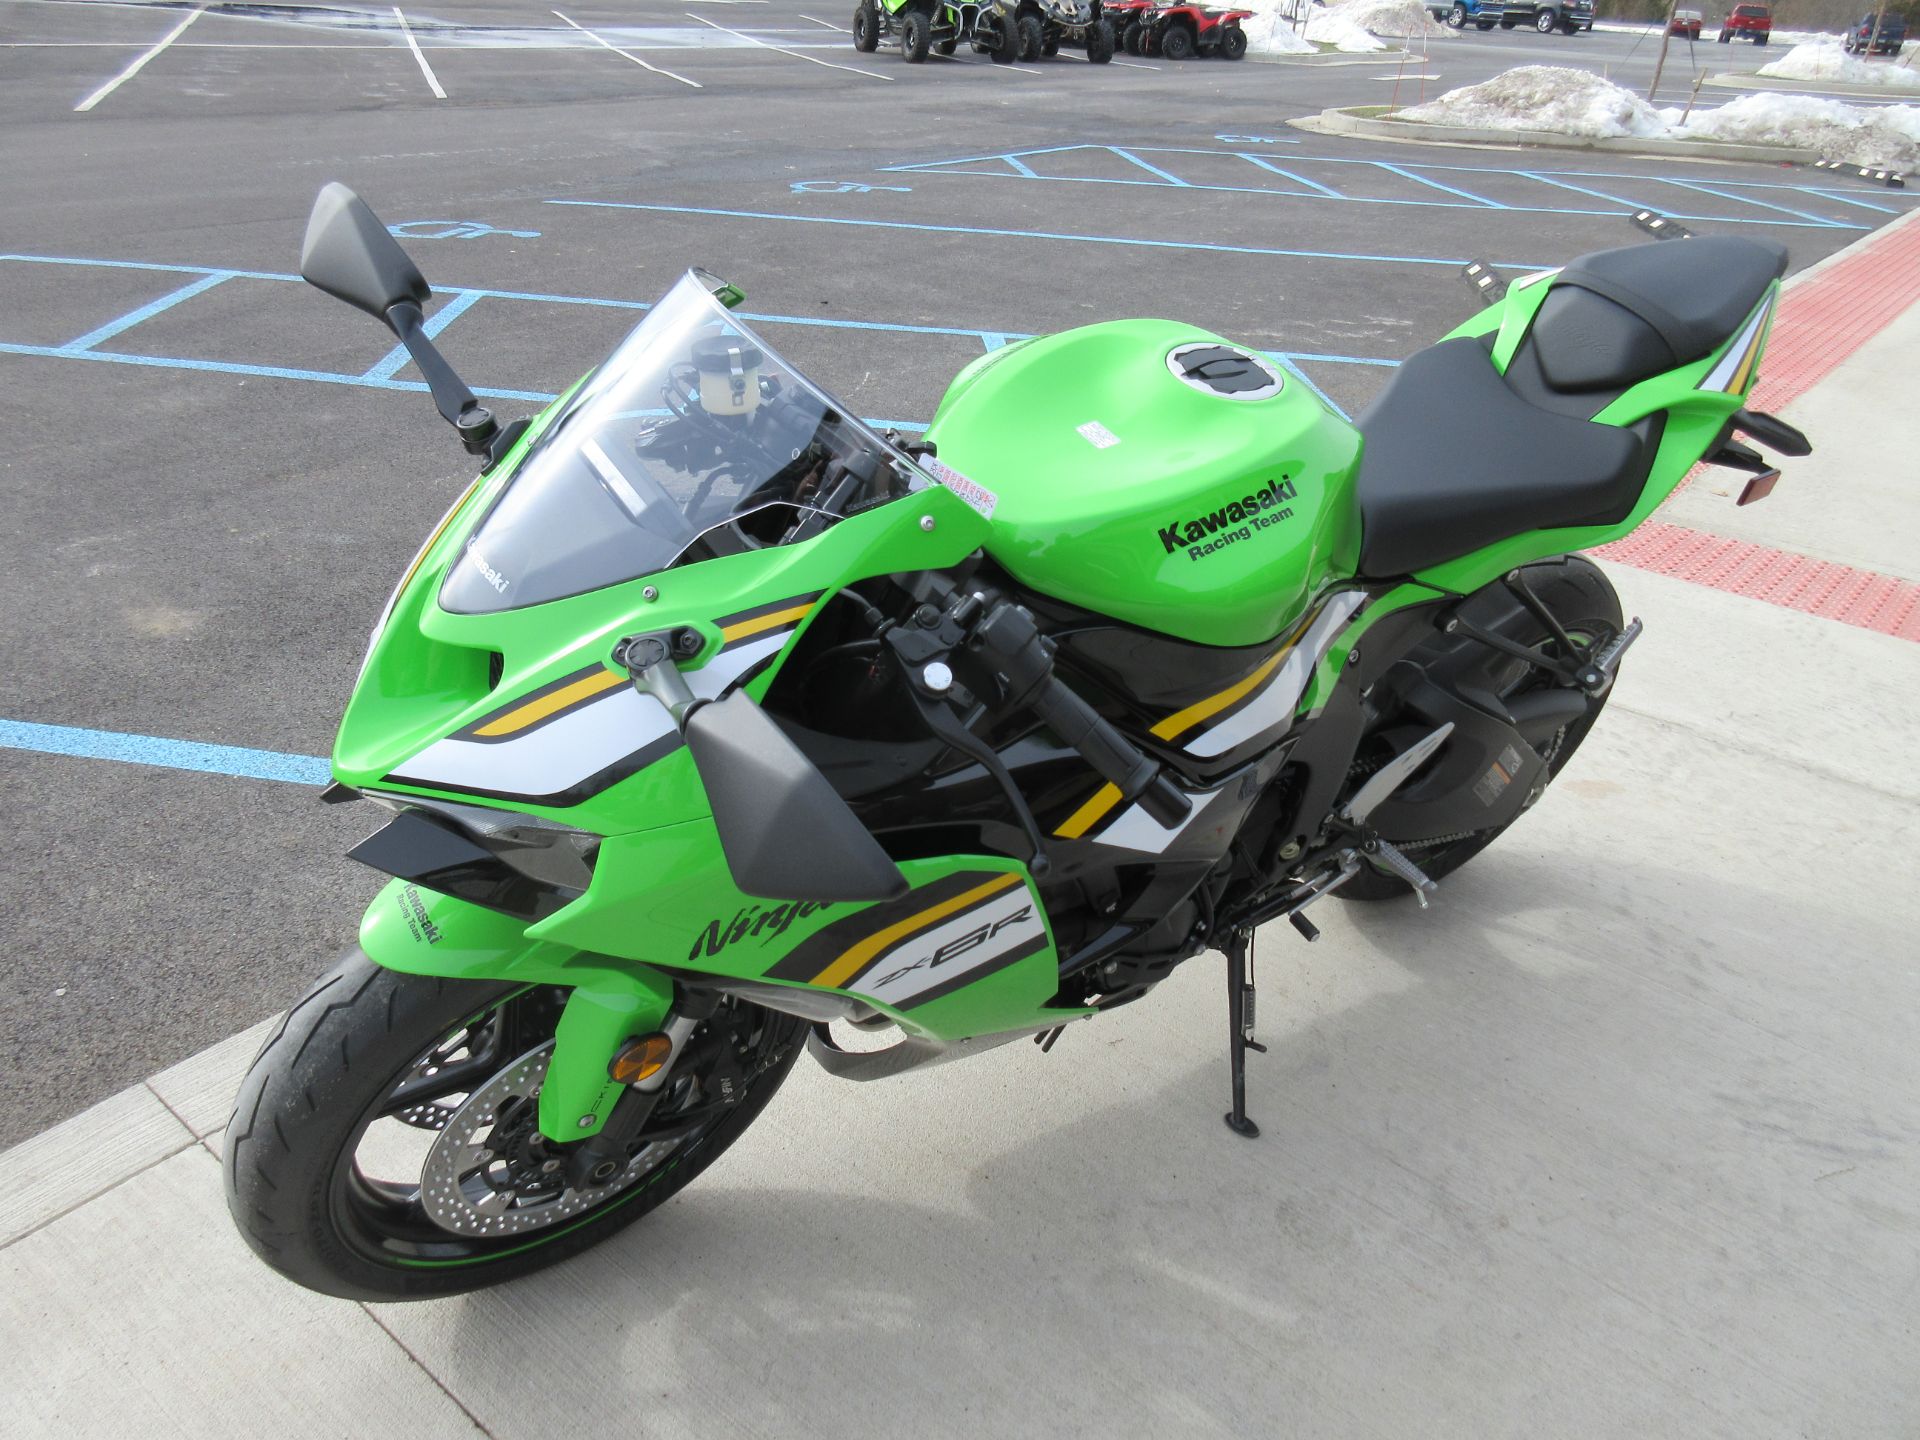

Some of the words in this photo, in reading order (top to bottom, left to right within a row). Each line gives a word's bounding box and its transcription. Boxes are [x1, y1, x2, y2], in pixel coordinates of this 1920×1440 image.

[1158, 474, 1298, 554] Kawasaki
[1187, 526, 1252, 561] Racing
[1249, 507, 1294, 532] Team
[467, 534, 510, 593] asaki
[404, 883, 443, 945] Kawasaki
[408, 918, 422, 942] Team
